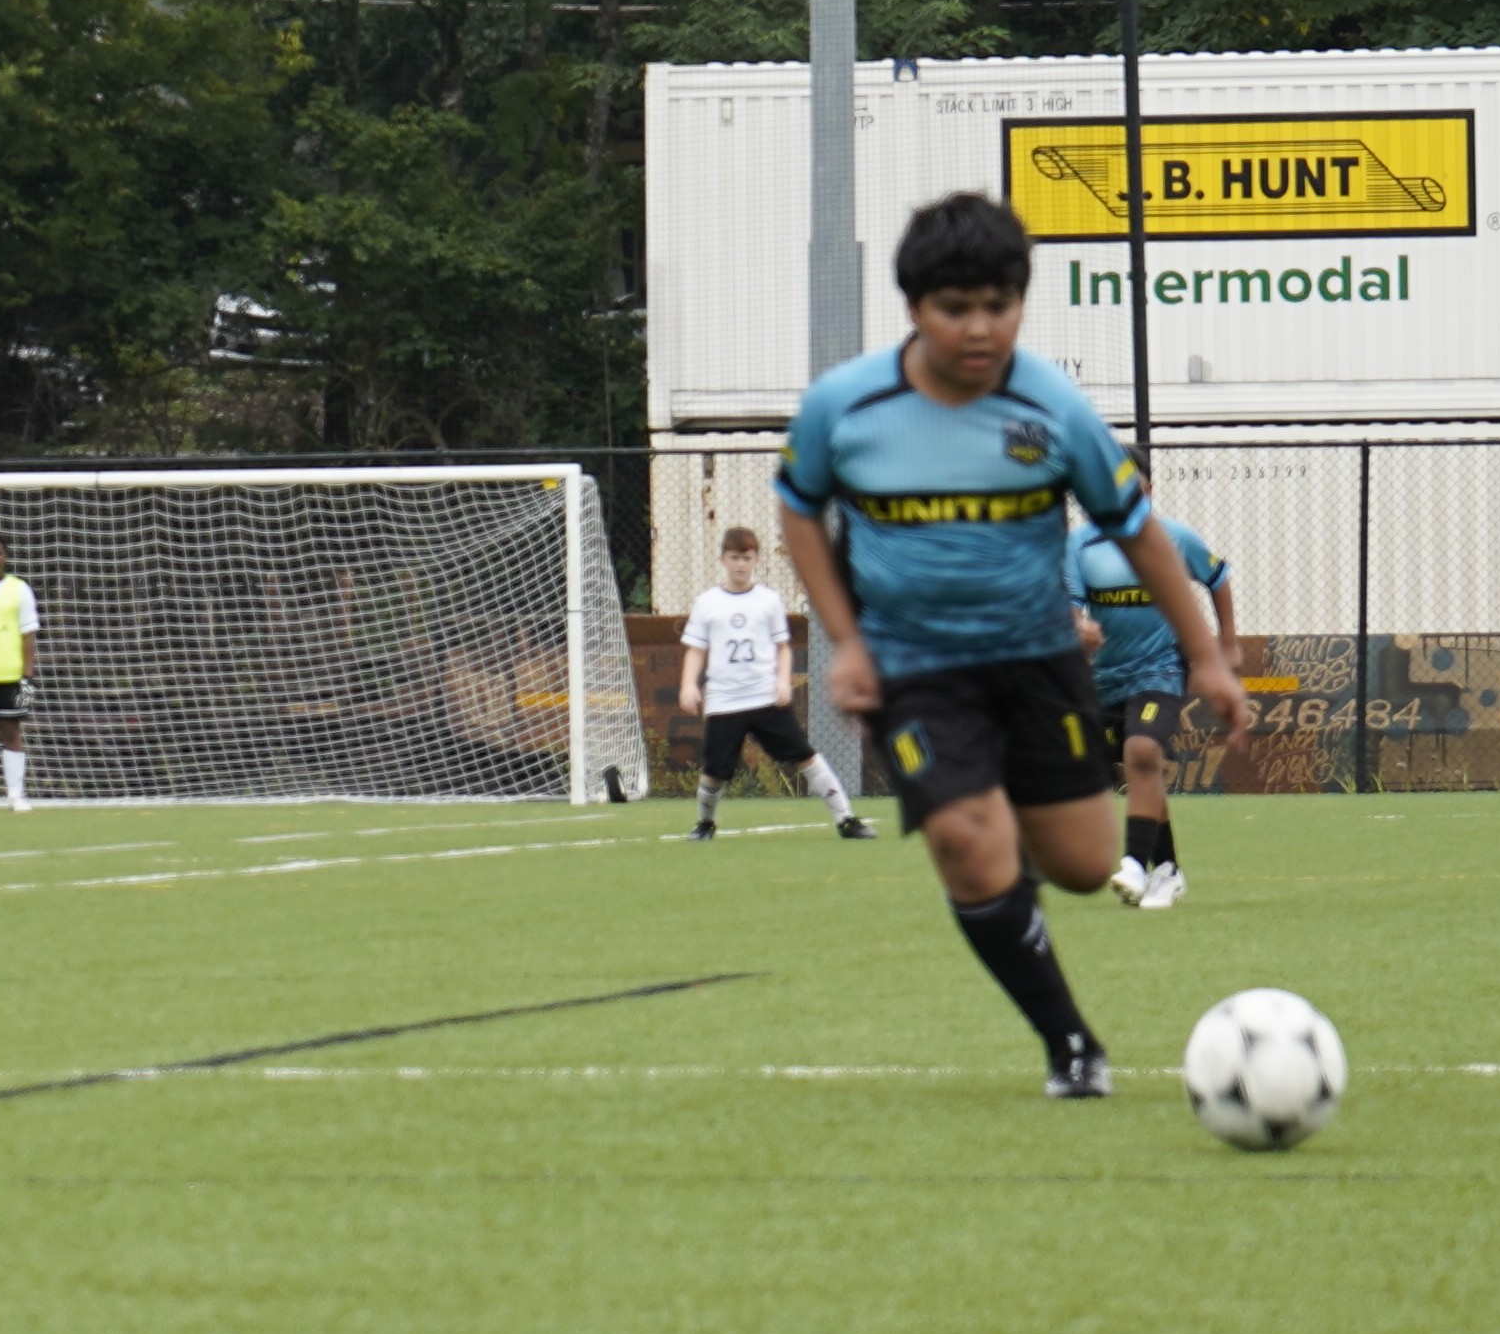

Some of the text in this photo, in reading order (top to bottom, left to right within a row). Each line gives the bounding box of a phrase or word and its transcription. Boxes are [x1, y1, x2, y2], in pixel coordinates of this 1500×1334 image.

[936, 98, 973, 114] STACK
[982, 98, 1016, 113] LIMIT
[1042, 97, 1073, 111] HIGH
[1222, 155, 1360, 198] HUNT
[857, 488, 1054, 524] UNITED
[725, 638, 756, 664] 23
